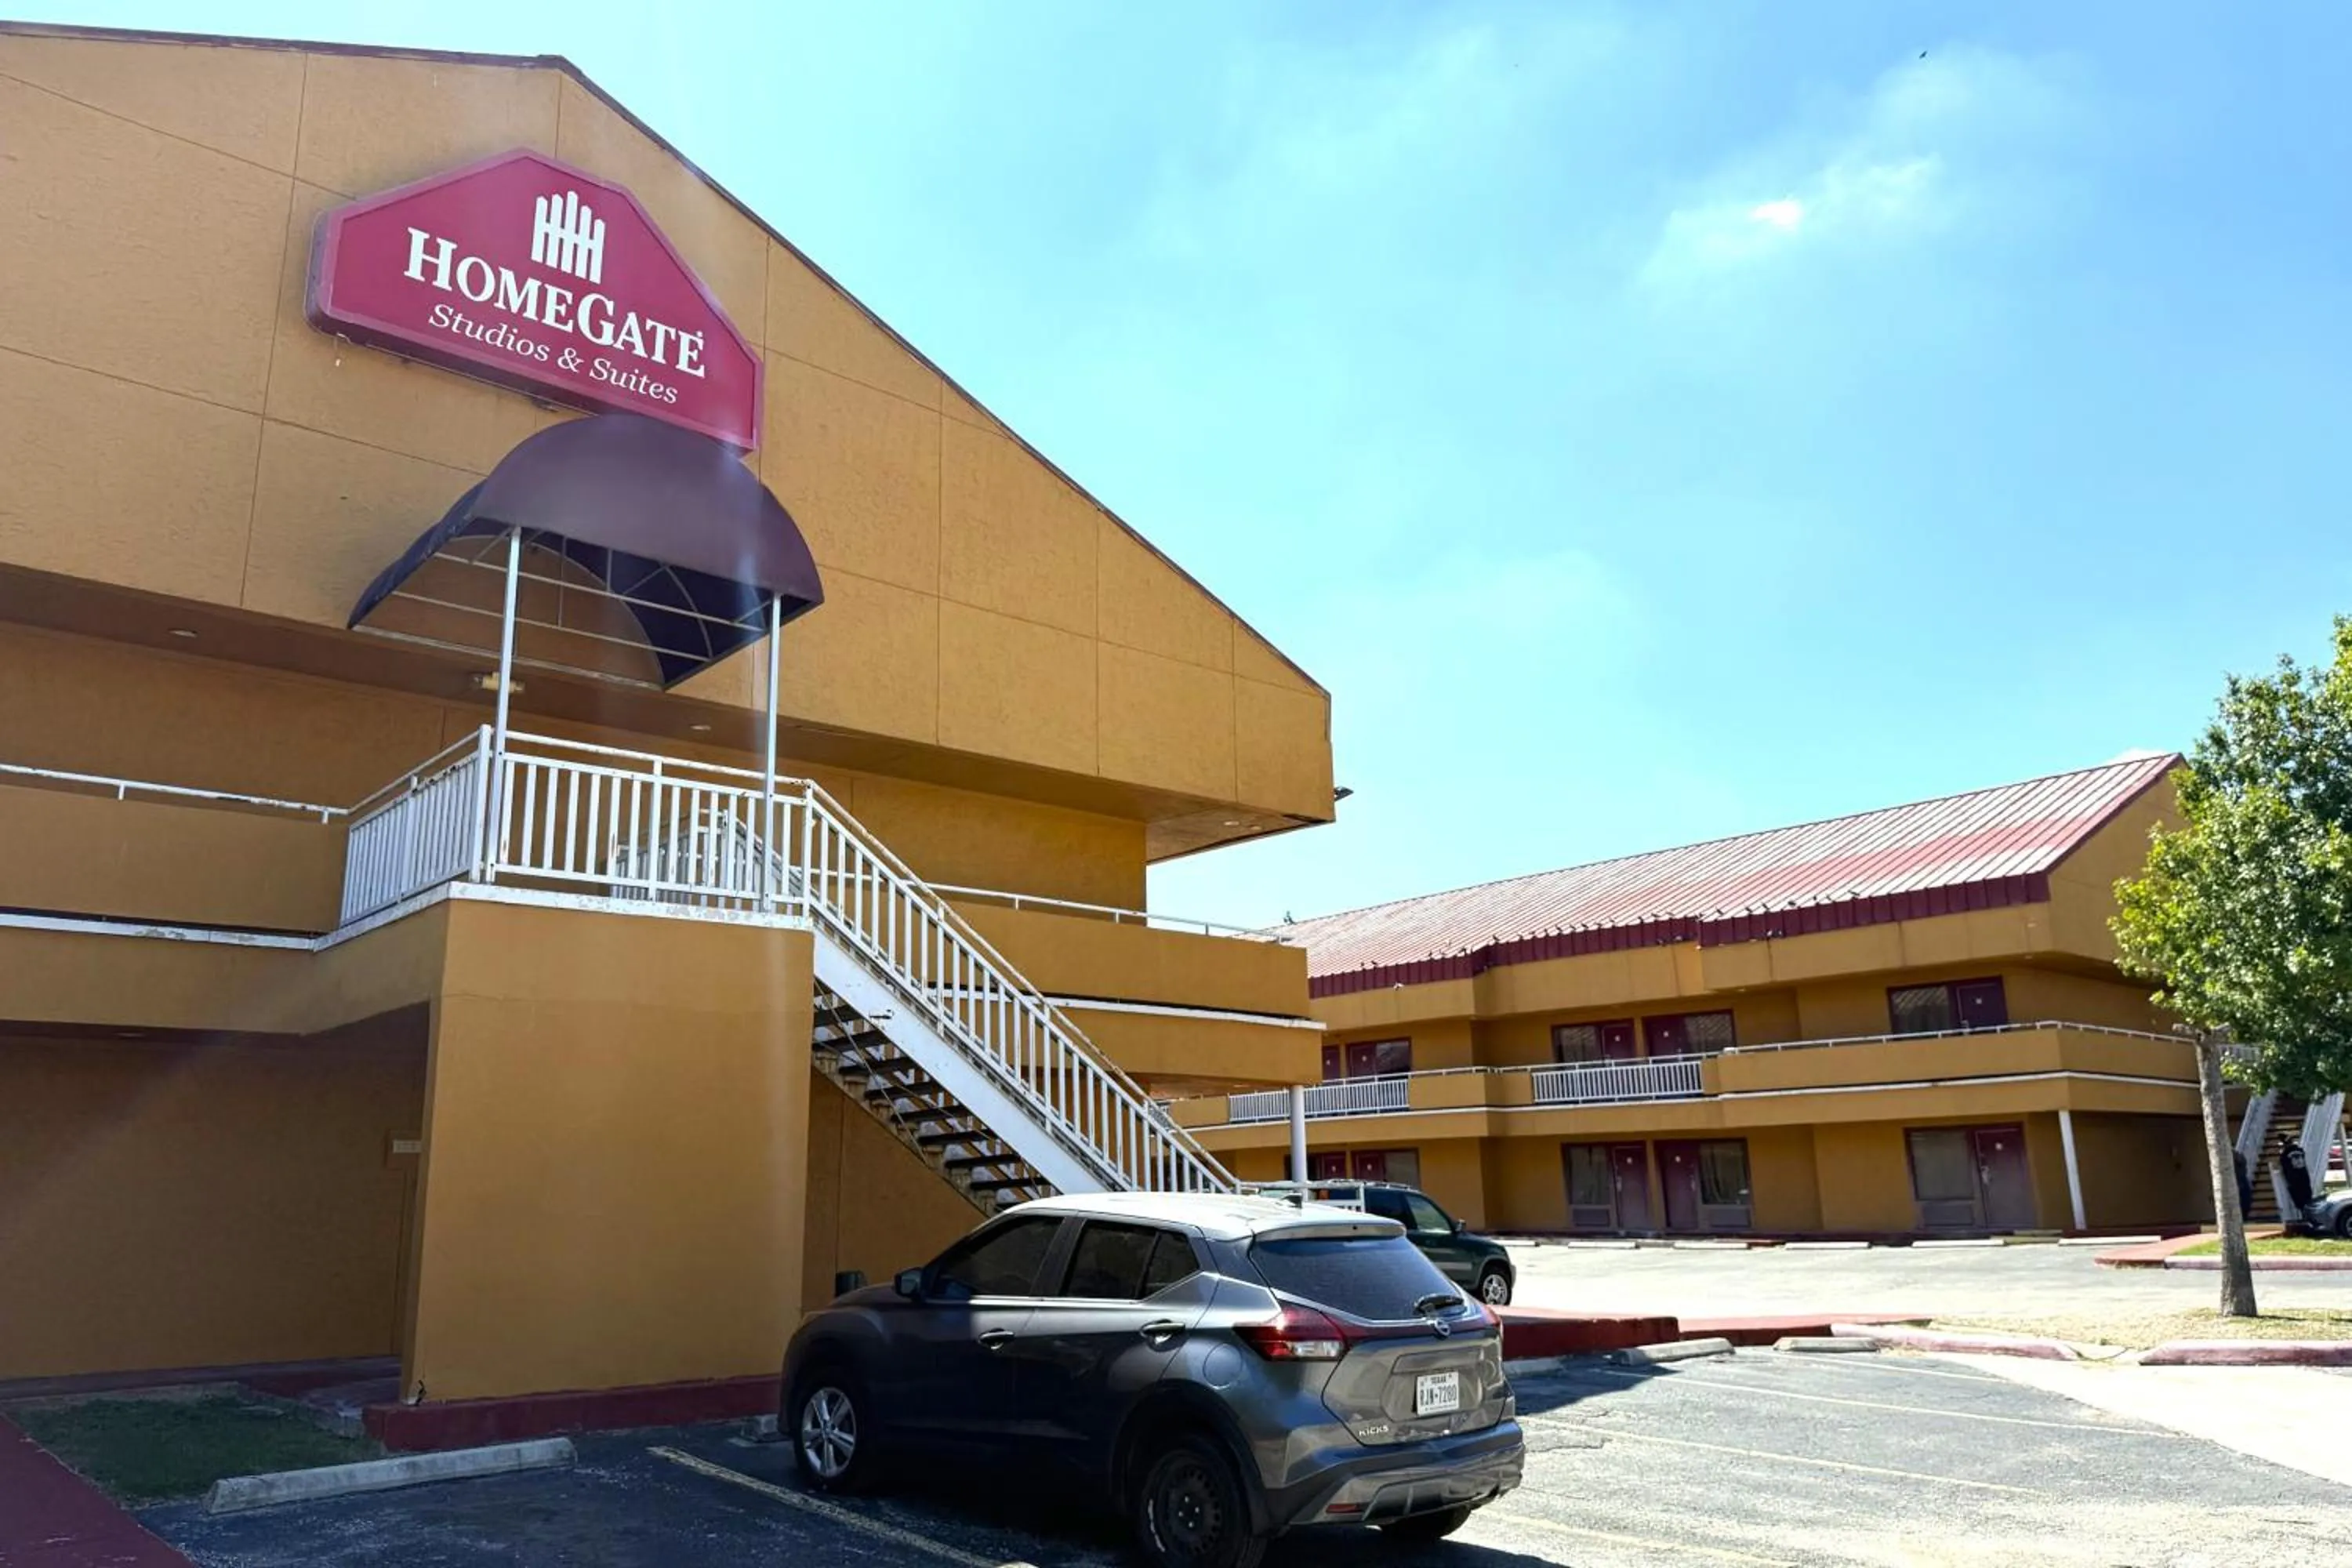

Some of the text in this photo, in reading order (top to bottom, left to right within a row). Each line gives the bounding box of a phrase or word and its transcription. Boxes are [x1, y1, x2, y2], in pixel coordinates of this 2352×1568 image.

[404, 227, 706, 378] HOMEGATE
[428, 303, 679, 405] Studios & Suites
